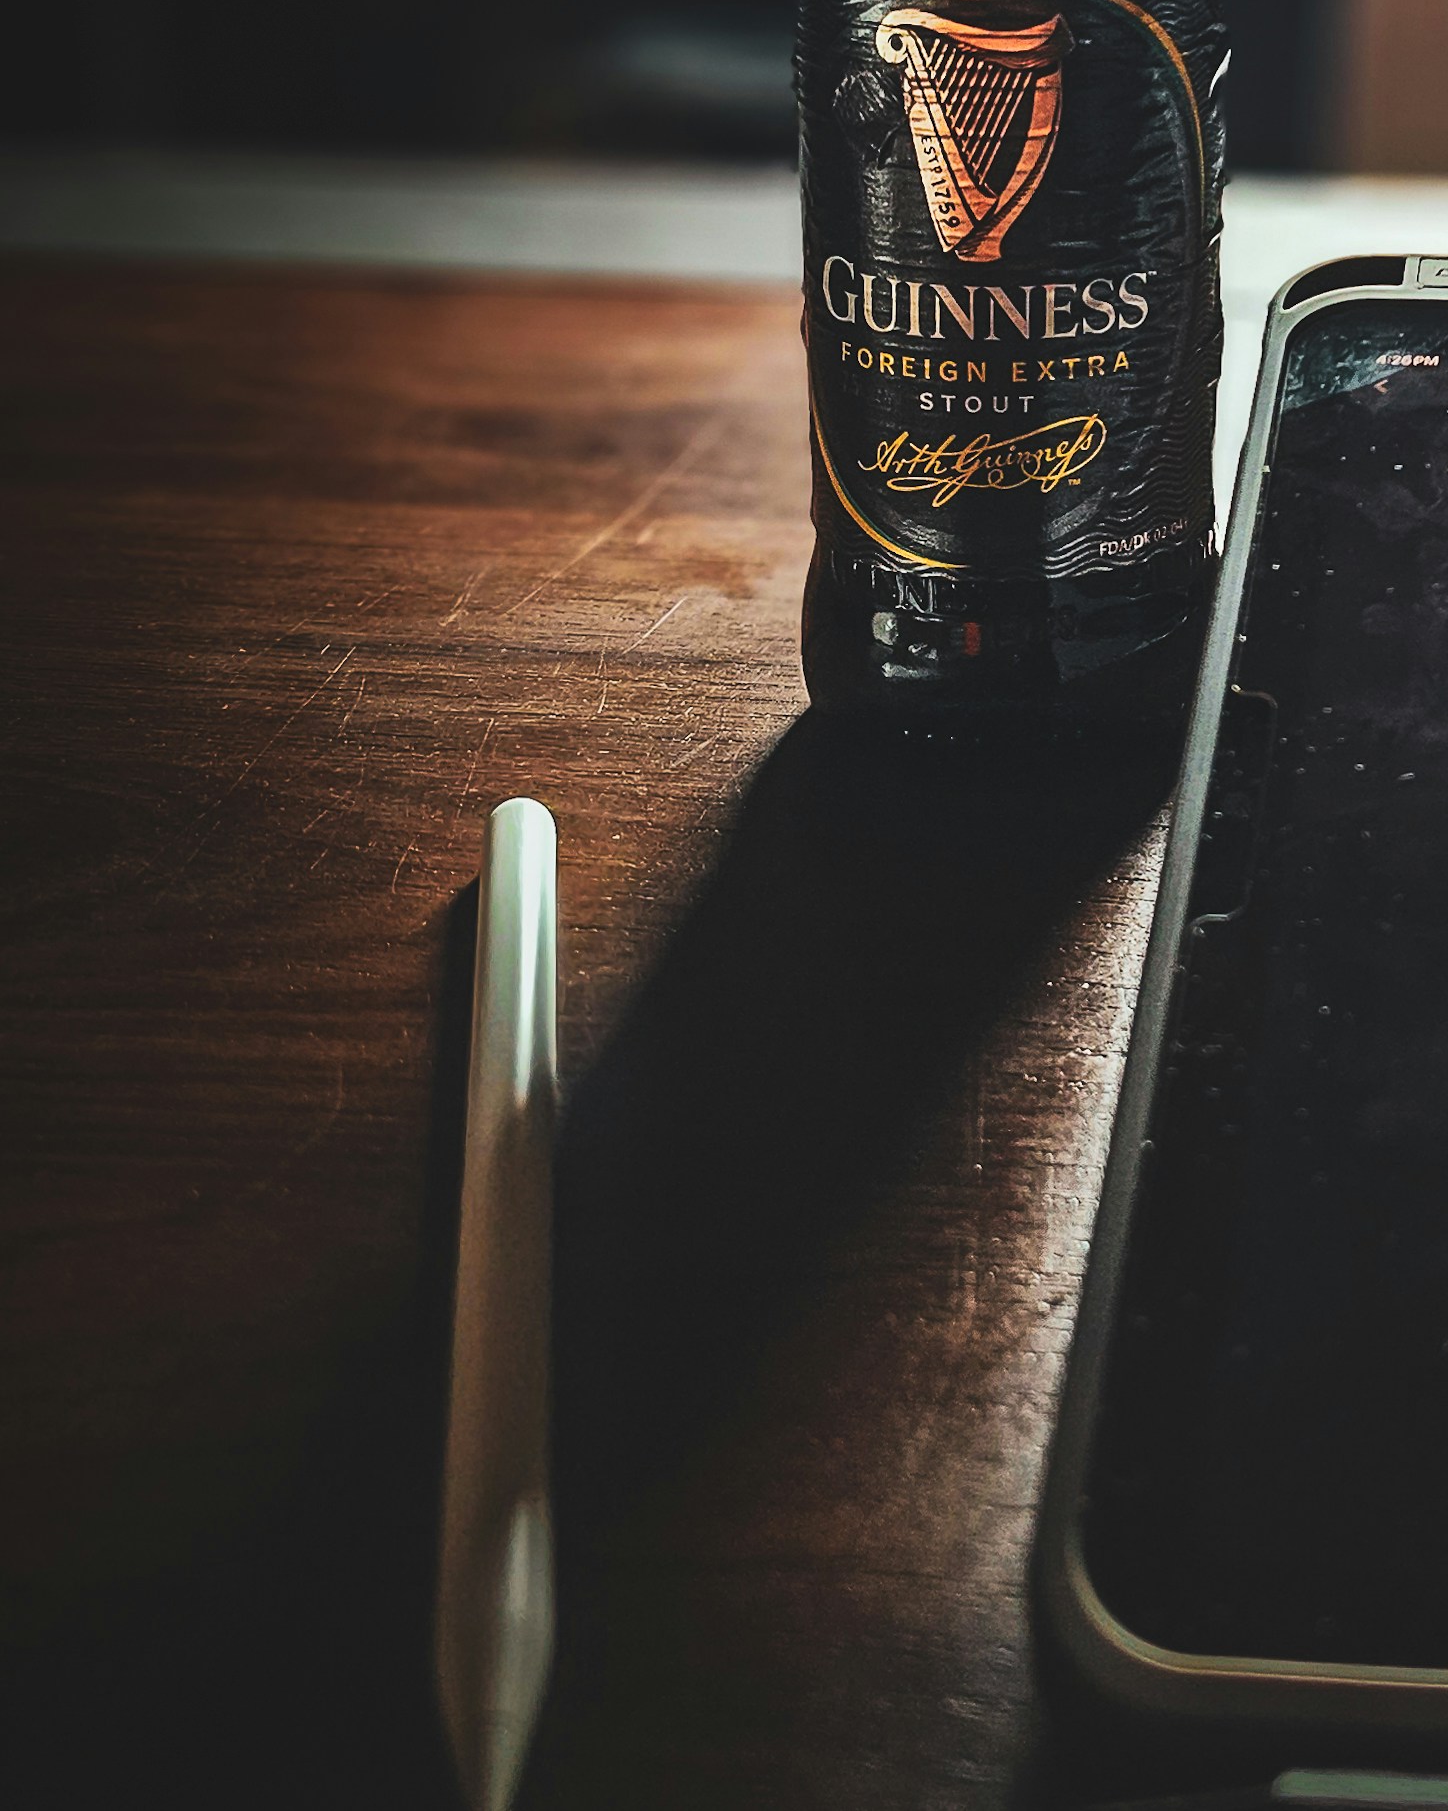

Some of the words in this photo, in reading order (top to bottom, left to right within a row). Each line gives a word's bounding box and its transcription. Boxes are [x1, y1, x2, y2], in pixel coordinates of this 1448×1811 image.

[931, 178, 961, 228] 1759
[823, 255, 1149, 341] GUINNESS
[842, 341, 987, 383] FOREIGN
[1012, 350, 1130, 383] EXTRA
[919, 392, 1035, 413] STOUT
